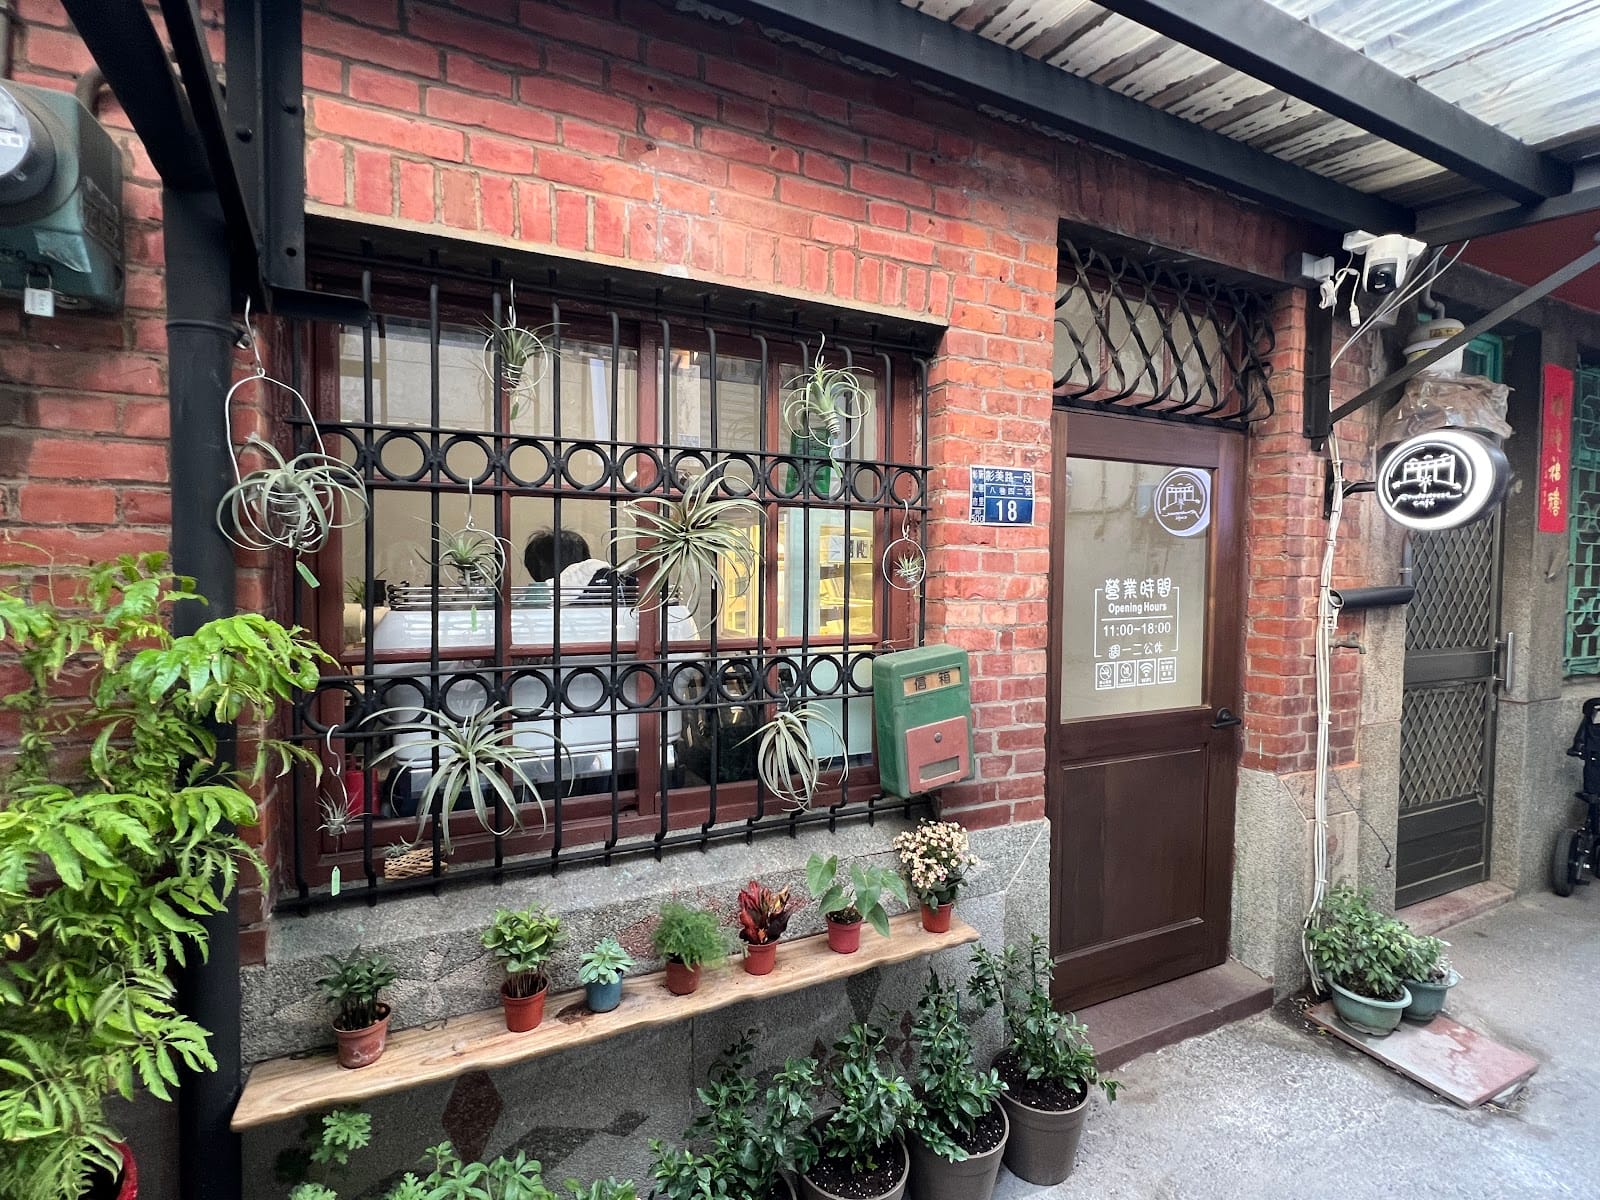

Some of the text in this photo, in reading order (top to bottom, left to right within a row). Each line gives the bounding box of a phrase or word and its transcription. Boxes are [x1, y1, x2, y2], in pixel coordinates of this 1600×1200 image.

[996, 499, 1018, 521] 18
[1105, 577, 1171, 600] 營業時間
[1108, 601, 1167, 615] Opening Hours
[914, 671, 951, 691] 信箱
